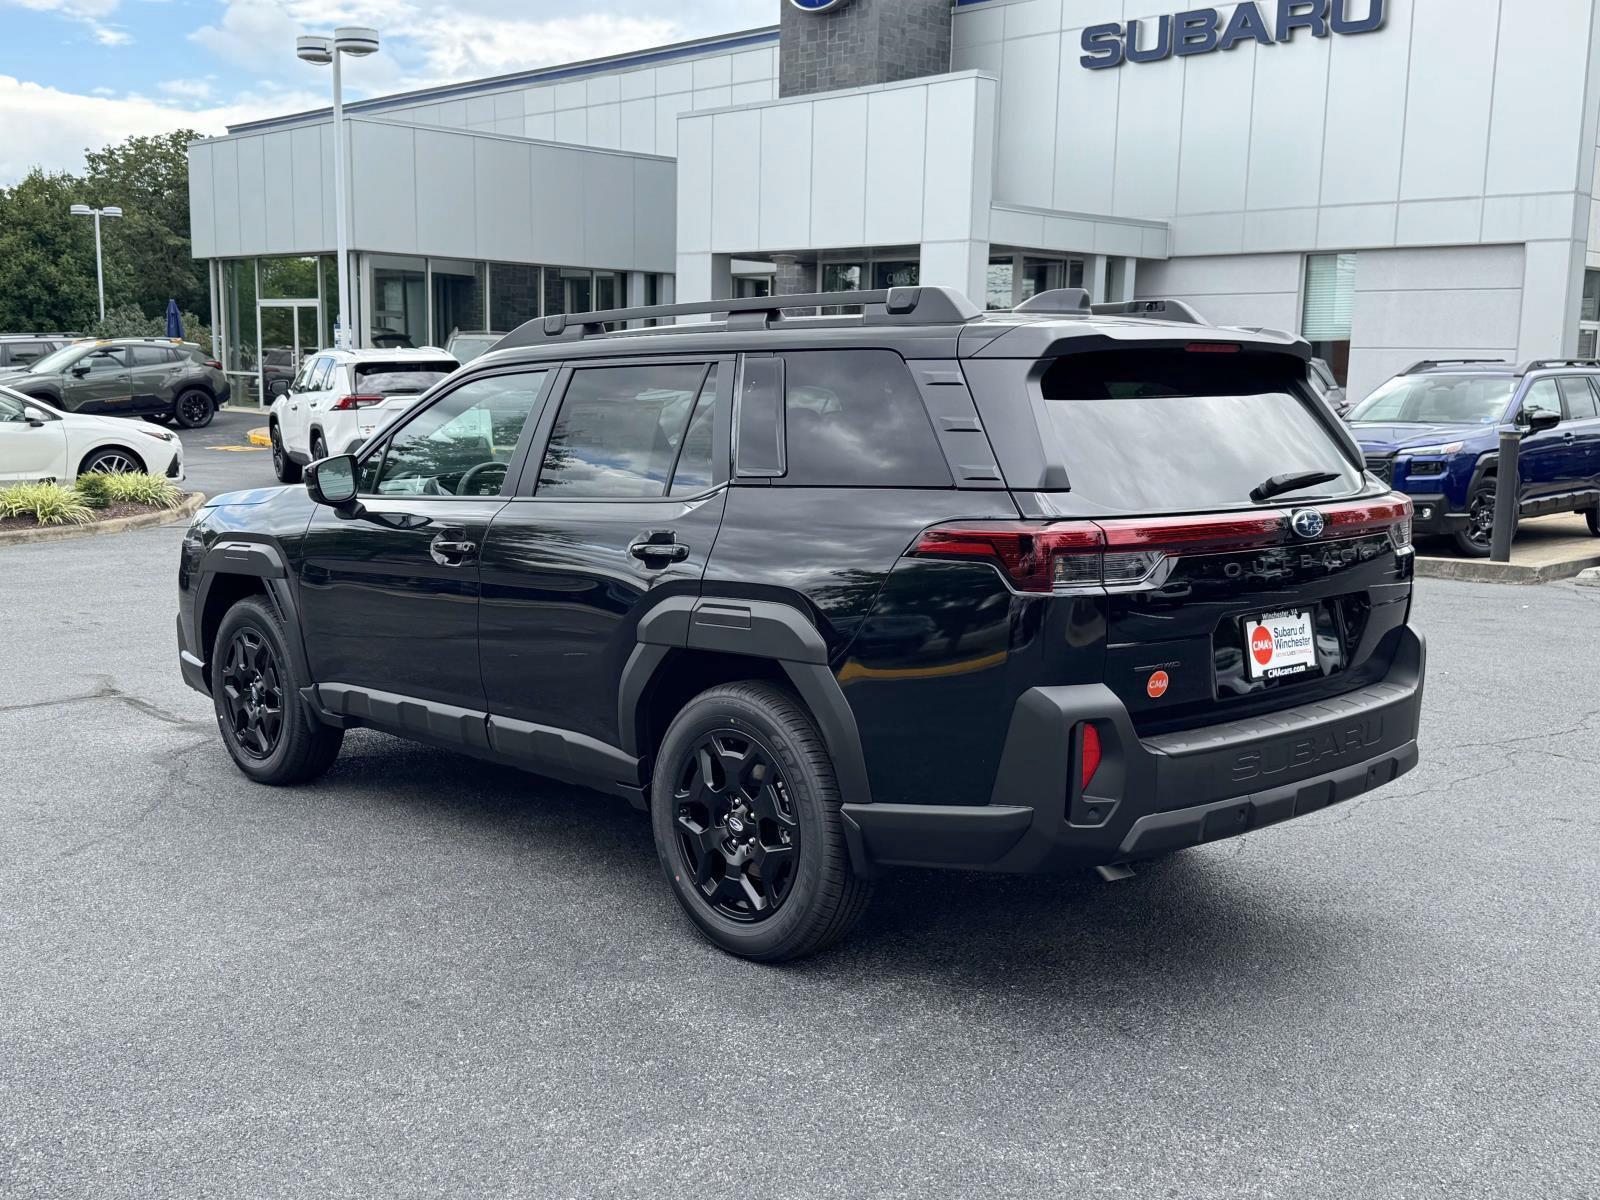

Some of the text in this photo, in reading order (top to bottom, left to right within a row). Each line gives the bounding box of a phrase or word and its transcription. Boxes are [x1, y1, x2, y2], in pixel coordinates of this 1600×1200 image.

[1080, 0, 1386, 69] SUBARU
[1224, 547, 1369, 578] OUTBACK
[1273, 624, 1305, 638] Subaru of
[1274, 637, 1311, 649] Winchester
[1267, 665, 1306, 678] CMAcars.com
[1150, 680, 1167, 689] CMA
[1232, 715, 1384, 782] SUBARU
